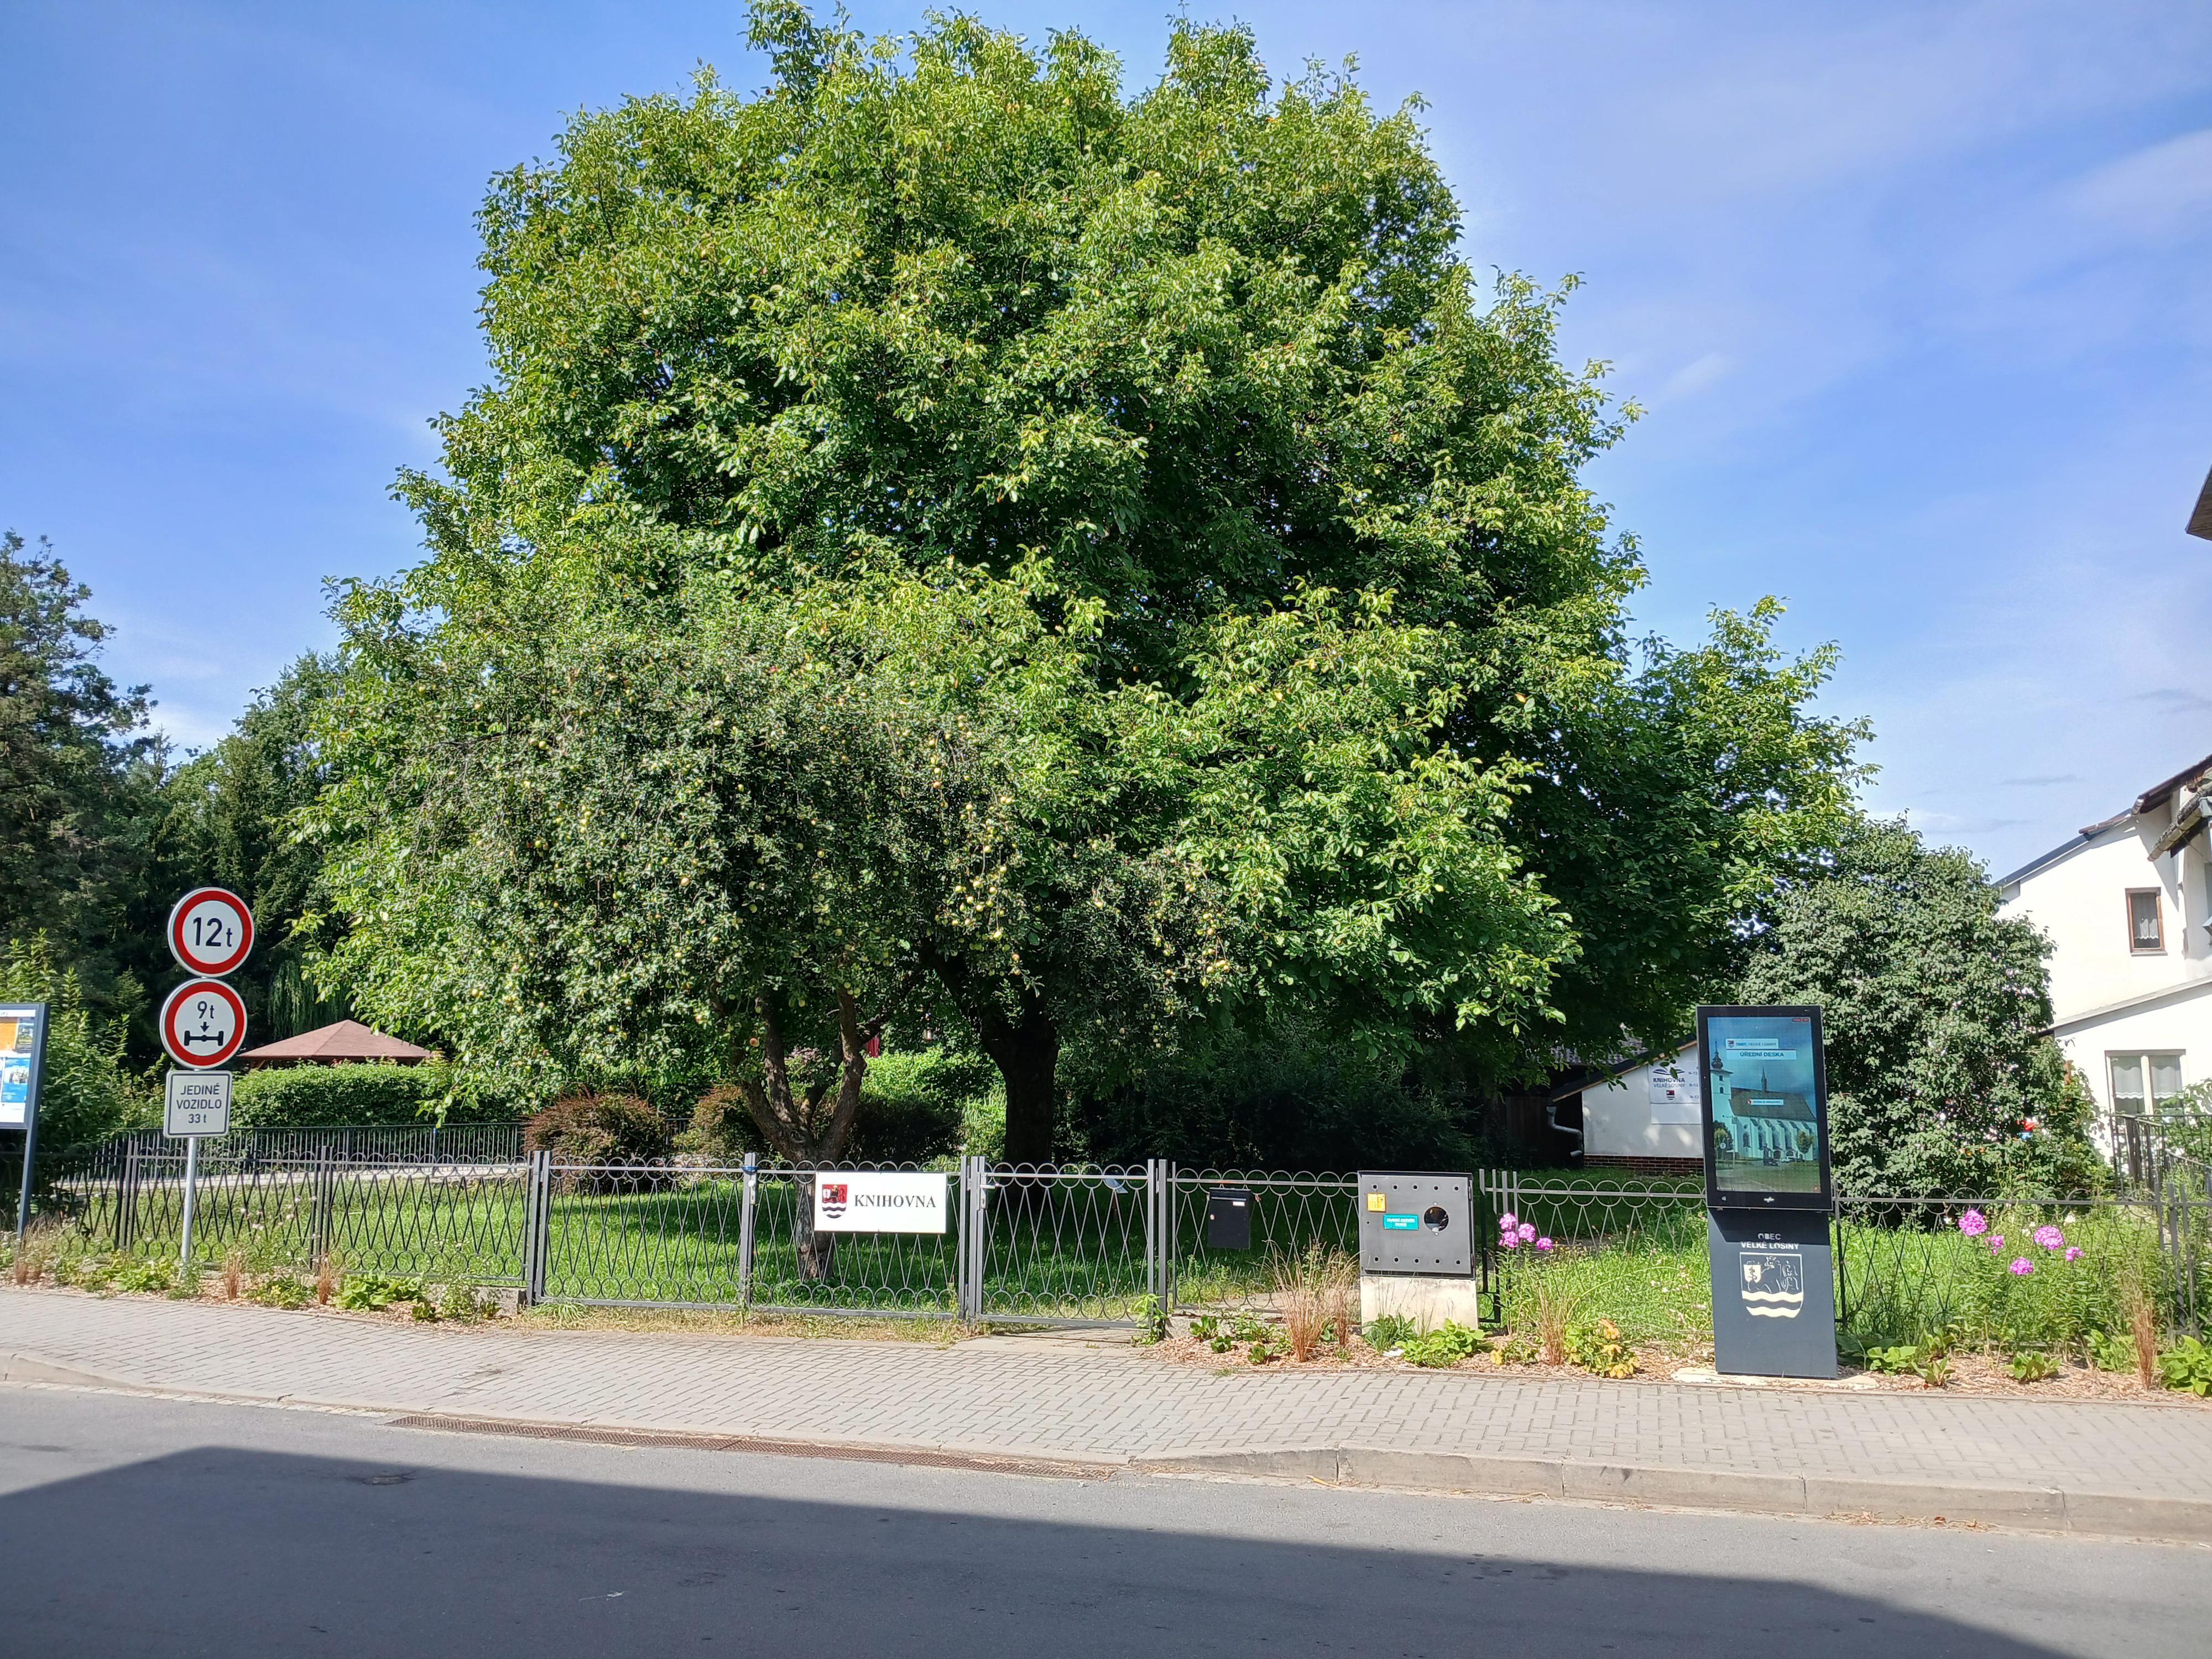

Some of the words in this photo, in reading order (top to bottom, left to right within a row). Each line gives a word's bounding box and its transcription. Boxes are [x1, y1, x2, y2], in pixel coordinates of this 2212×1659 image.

[180, 1083, 220, 1095] JEDINÉ
[176, 1099, 222, 1109] VOZIDLO
[854, 1194, 936, 1208] KNIHOVNA
